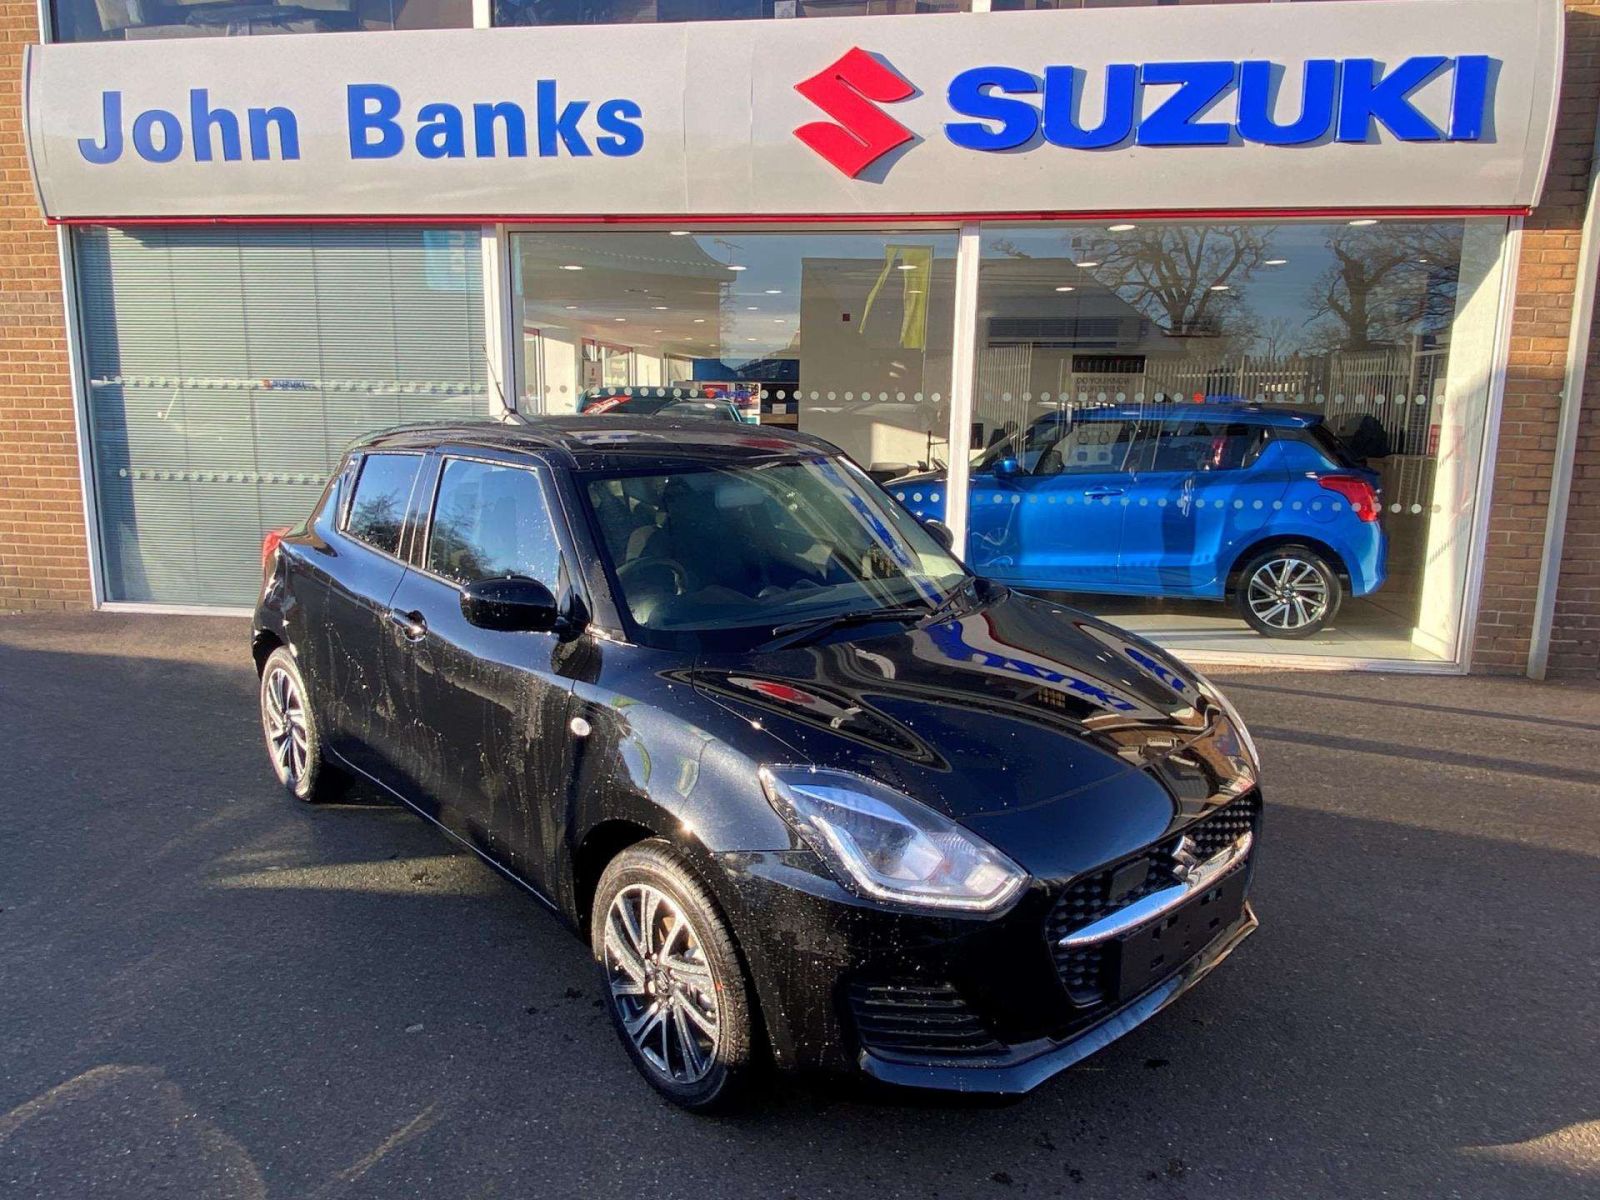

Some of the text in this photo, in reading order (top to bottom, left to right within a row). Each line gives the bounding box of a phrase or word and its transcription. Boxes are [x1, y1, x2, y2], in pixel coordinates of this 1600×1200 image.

[77, 79, 644, 165] John Banks
[943, 55, 1489, 151] SUZUKI
